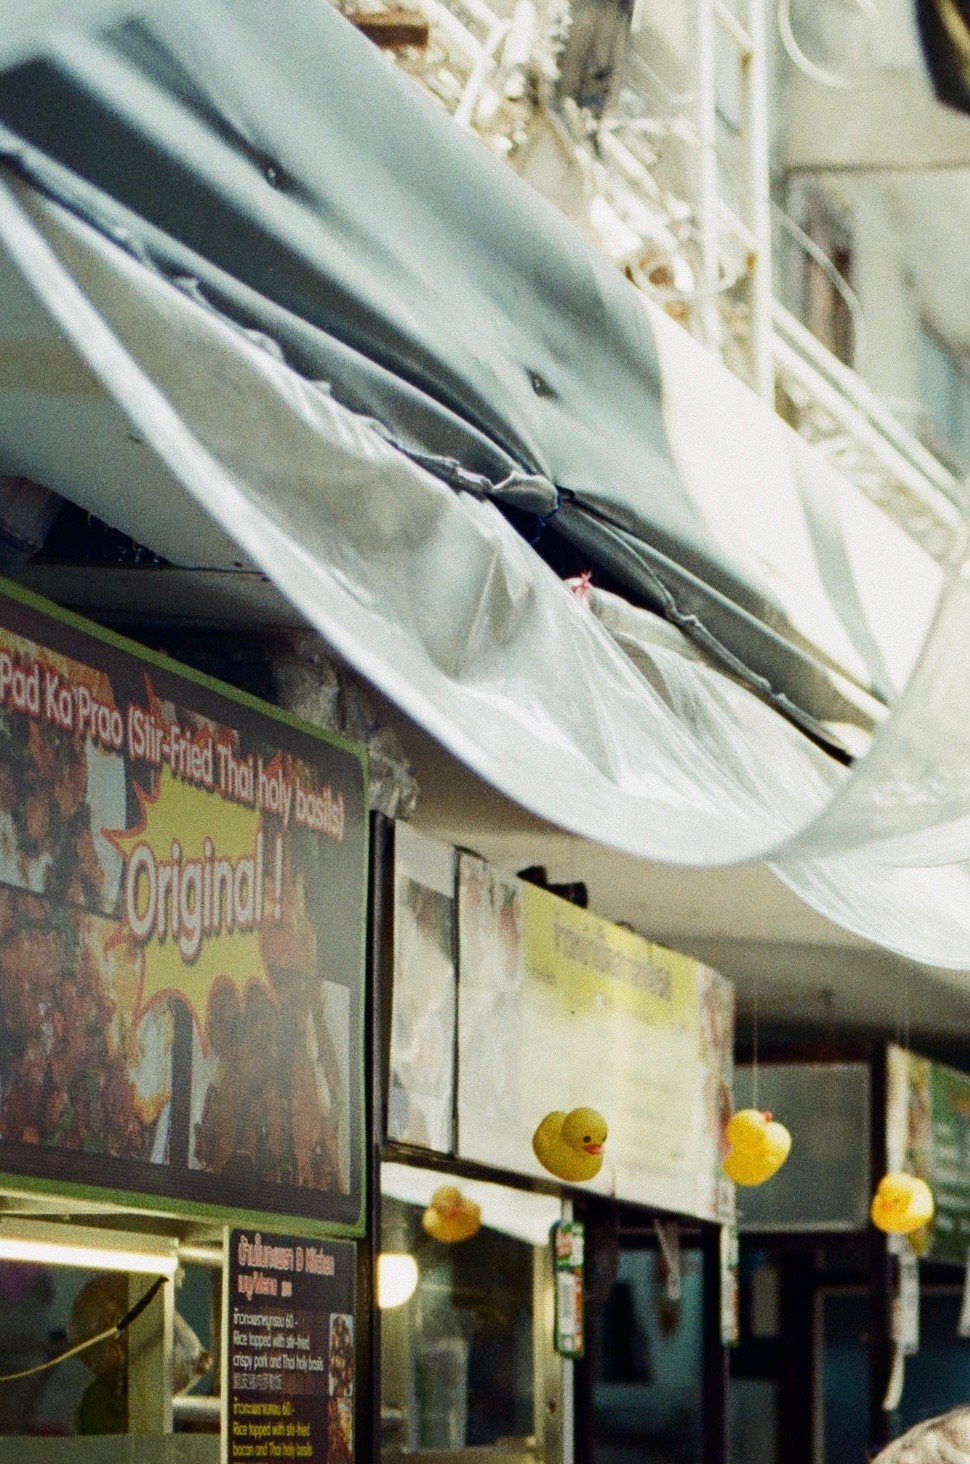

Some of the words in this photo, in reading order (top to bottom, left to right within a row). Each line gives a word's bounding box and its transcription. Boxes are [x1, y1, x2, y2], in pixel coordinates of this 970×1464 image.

[0, 653, 39, 717] Pad
[217, 744, 255, 798] Thai
[258, 756, 293, 826] holy
[127, 831, 264, 957] Original
